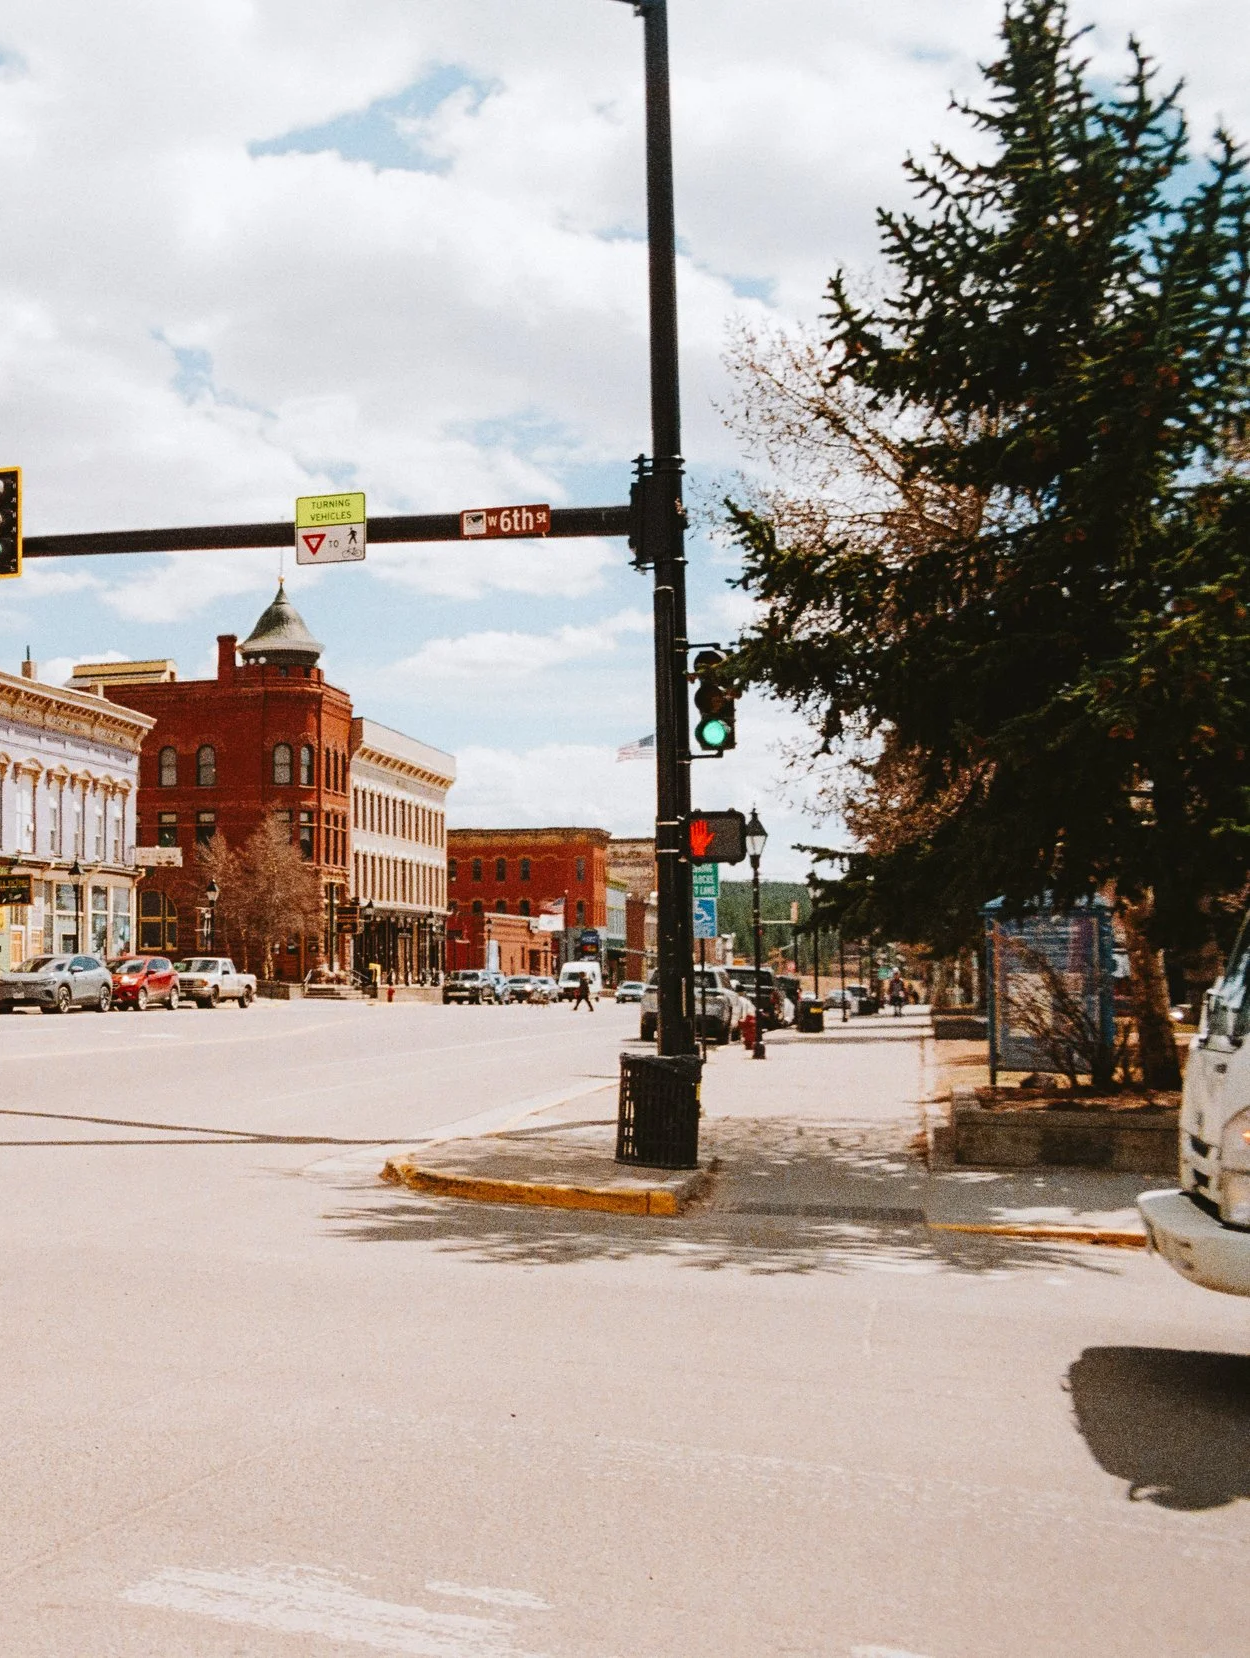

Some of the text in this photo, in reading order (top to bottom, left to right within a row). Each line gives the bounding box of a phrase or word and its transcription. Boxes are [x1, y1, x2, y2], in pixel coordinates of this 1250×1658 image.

[311, 499, 351, 509] TURNING
[310, 511, 352, 521] VEHICLES
[487, 507, 547, 532] W 6th St
[329, 540, 340, 548] TO
